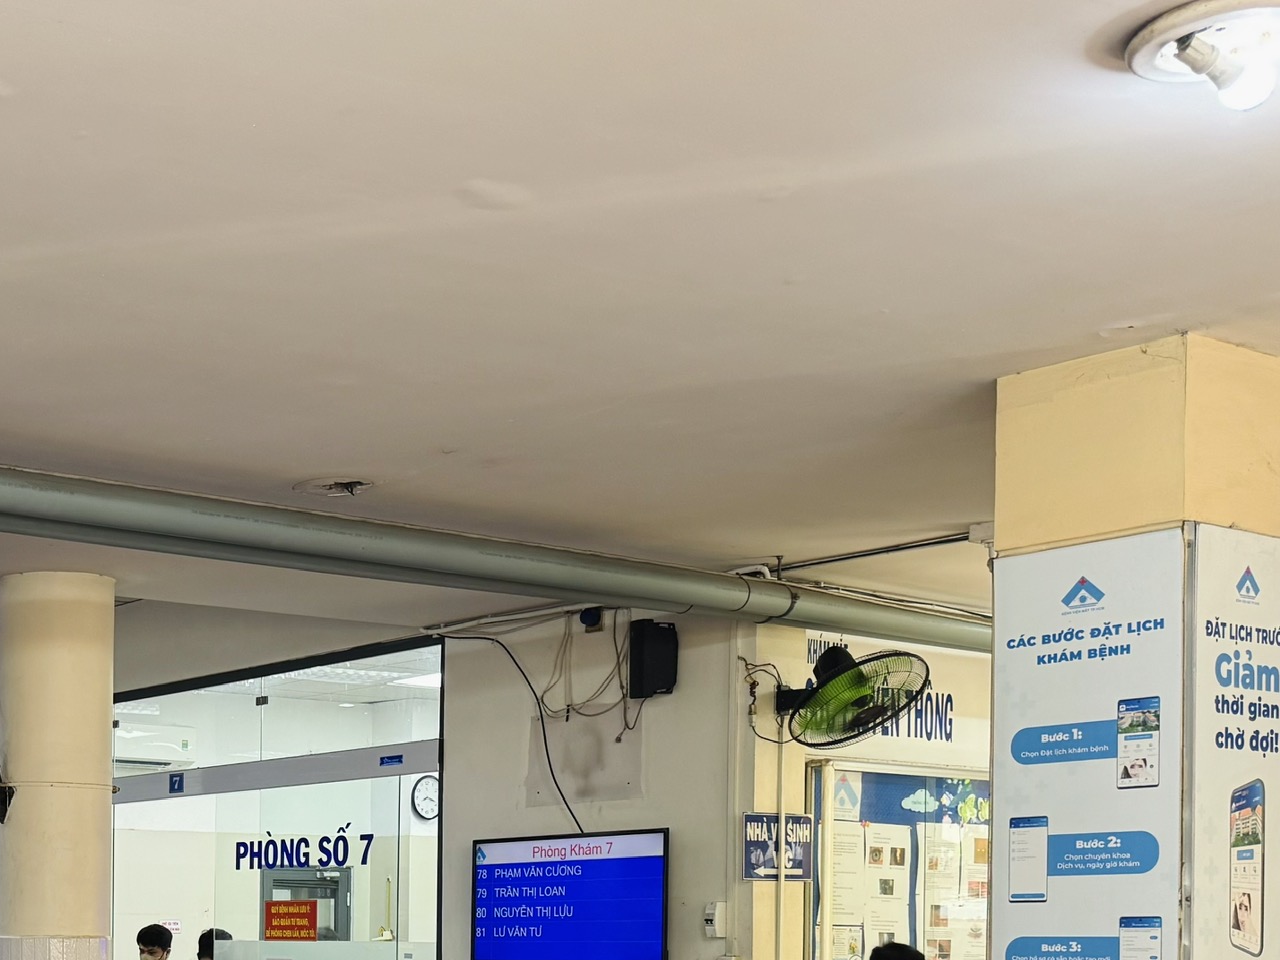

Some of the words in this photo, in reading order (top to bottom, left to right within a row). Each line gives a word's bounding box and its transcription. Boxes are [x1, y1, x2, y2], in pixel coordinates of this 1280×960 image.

[1006, 634, 1037, 649] CÁC
[1041, 627, 1085, 645] BƯỚC
[1089, 621, 1123, 640] ĐẶT
[1127, 617, 1165, 636] LỊCH
[1205, 616, 1227, 643] ĐẶT
[1229, 623, 1253, 645] LỊCH
[1036, 647, 1082, 666] KHÁM
[1087, 643, 1131, 661] BỆNH
[1214, 648, 1280, 692] Giảm
[1214, 693, 1244, 716] thời
[1248, 696, 1279, 722] gian
[1040, 732, 1070, 744] Bước
[1071, 728, 1083, 741] 1:
[1214, 726, 1245, 751] chờ
[1249, 729, 1279, 759] đợi!
[1020, 751, 1039, 759] Chọn
[1040, 748, 1053, 758] Đặt
[1054, 747, 1067, 757] lịch
[1067, 746, 1089, 754] khám
[1089, 744, 1109, 753] bệnh
[172, 776, 180, 790] 7
[746, 816, 768, 842] NHÀ
[235, 830, 311, 870] PHÒNG
[317, 821, 352, 868] SỐ
[359, 833, 374, 866] 7
[1075, 837, 1105, 849] Bước
[1107, 835, 1121, 848] 2:
[532, 844, 567, 861] Phòng
[570, 842, 602, 857] Khám
[606, 841, 613, 855] 7
[1064, 853, 1084, 862] Chọn
[1084, 852, 1111, 862] chuyên
[1112, 851, 1131, 860] khoa
[476, 869, 488, 879] 78
[494, 867, 522, 880] PHẠM
[523, 865, 543, 877] VĂN
[1056, 862, 1074, 870] Dịch
[1086, 861, 1104, 870] ngày
[1105, 860, 1118, 869] giờ
[1118, 859, 1141, 867] khám
[476, 888, 487, 898] 79
[494, 885, 520, 898] TRẦN
[521, 886, 537, 899] THỊ
[539, 885, 566, 897] LOAN
[476, 907, 487, 918] 80
[493, 904, 534, 918] NGUYỄN
[535, 905, 552, 919] THỊ
[553, 903, 574, 919] LỰU
[475, 927, 486, 937] 81
[507, 925, 527, 937] VĂN
[1041, 942, 1068, 953] Bước
[1069, 941, 1082, 953] 3:
